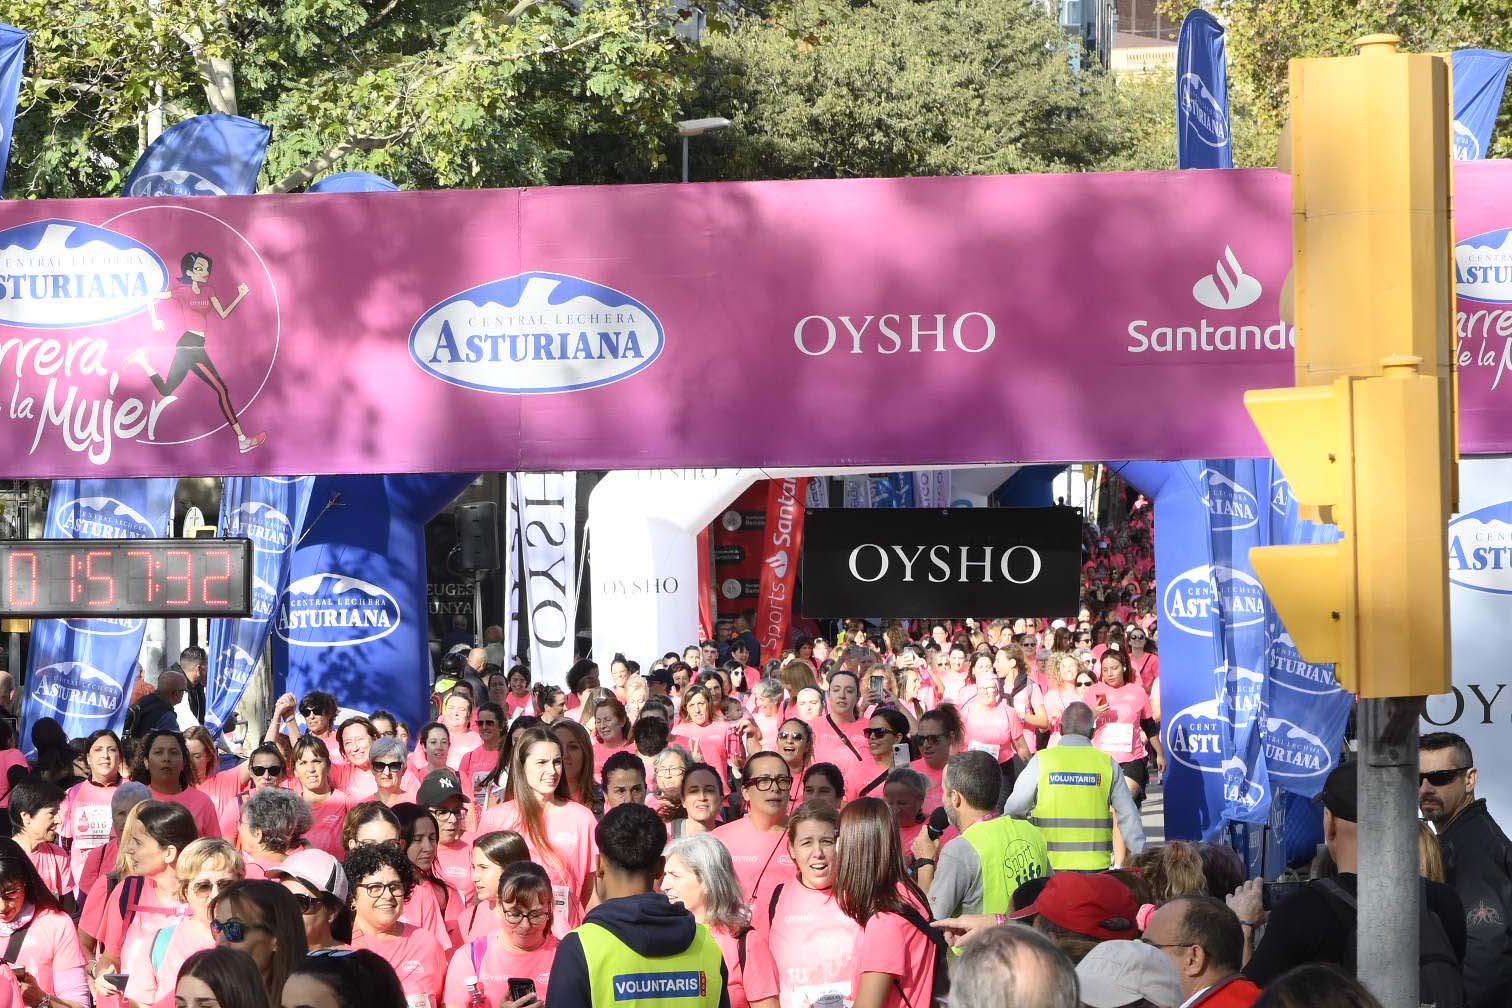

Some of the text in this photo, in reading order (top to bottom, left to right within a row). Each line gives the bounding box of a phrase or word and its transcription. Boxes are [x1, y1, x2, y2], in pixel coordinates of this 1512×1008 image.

[468, 313, 636, 328] CENTRAL LECHERA
[794, 312, 996, 356] OYSHO
[428, 319, 644, 363] ASTURIANA
[1478, 339, 1496, 366] la
[10, 379, 34, 419] la
[28, 372, 178, 465] Mujer
[848, 543, 1042, 584] OYSHO
[602, 576, 679, 594] OYSHO
[291, 597, 386, 607] CENTRAL LECHERA
[279, 605, 391, 630] ASTURIANA
[760, 582, 786, 650] Sports
[1050, 773, 1096, 783] VOLUNTARIS
[1005, 844, 1035, 878] Sport
[615, 977, 698, 994] VOLUNTARIS
